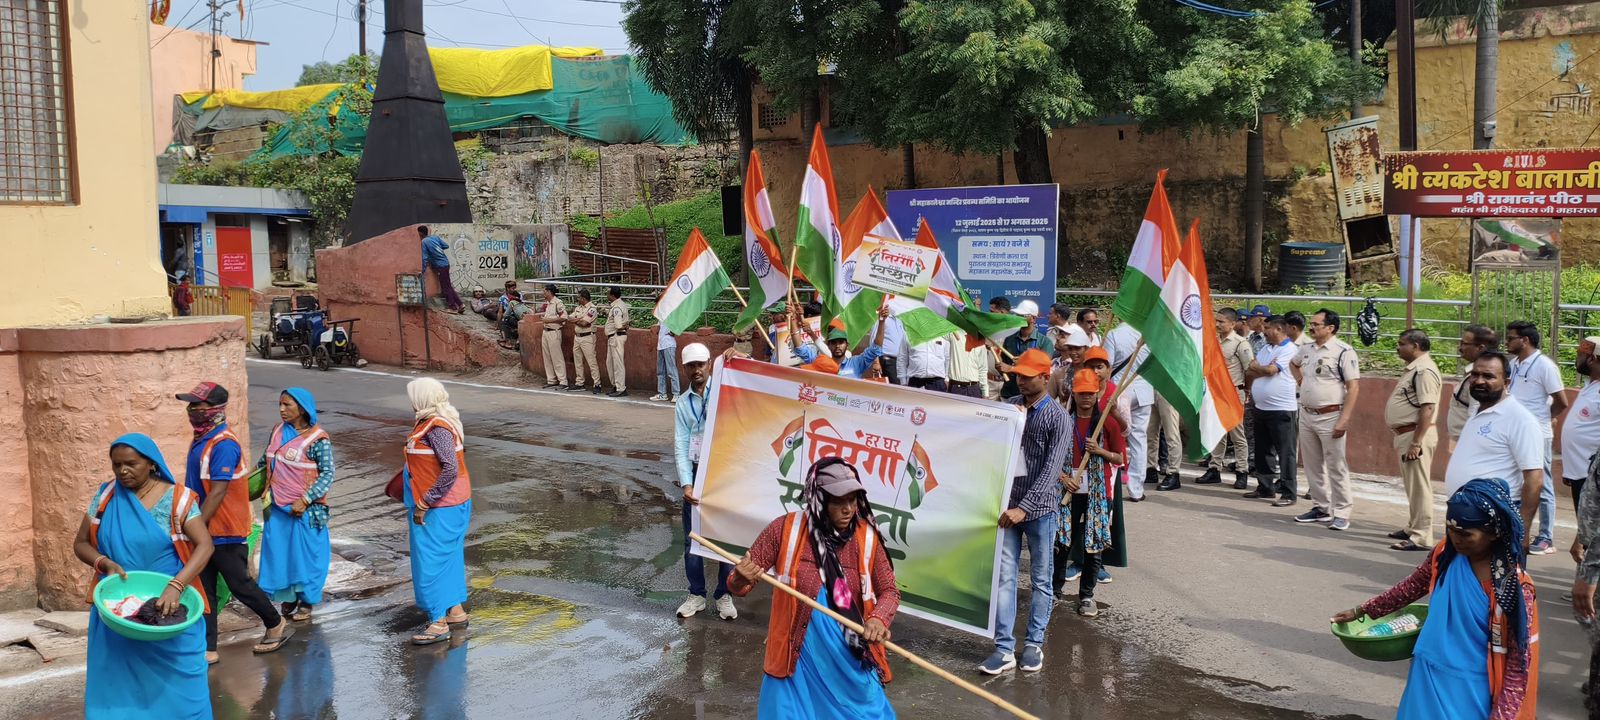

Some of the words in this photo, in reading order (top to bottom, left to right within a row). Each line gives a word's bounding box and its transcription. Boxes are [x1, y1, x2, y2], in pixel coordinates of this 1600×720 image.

[1392, 164, 1419, 189] श्री
[1422, 163, 1511, 189] व्यंकटेश
[1515, 161, 1600, 189] बालाजी
[1466, 192, 1485, 204] श्री
[1487, 191, 1546, 204] रामानंद
[1549, 191, 1583, 204] पीठ
[1476, 205, 1488, 213] श्री
[1540, 205, 1554, 213] जी
[962, 217, 980, 228] जुलाई
[997, 217, 1003, 226] से
[1003, 218, 1010, 226] 17
[881, 249, 915, 268] तिरंगा
[870, 263, 919, 283] स्वच्छता
[865, 433, 881, 448] हर
[883, 436, 901, 452] घर
